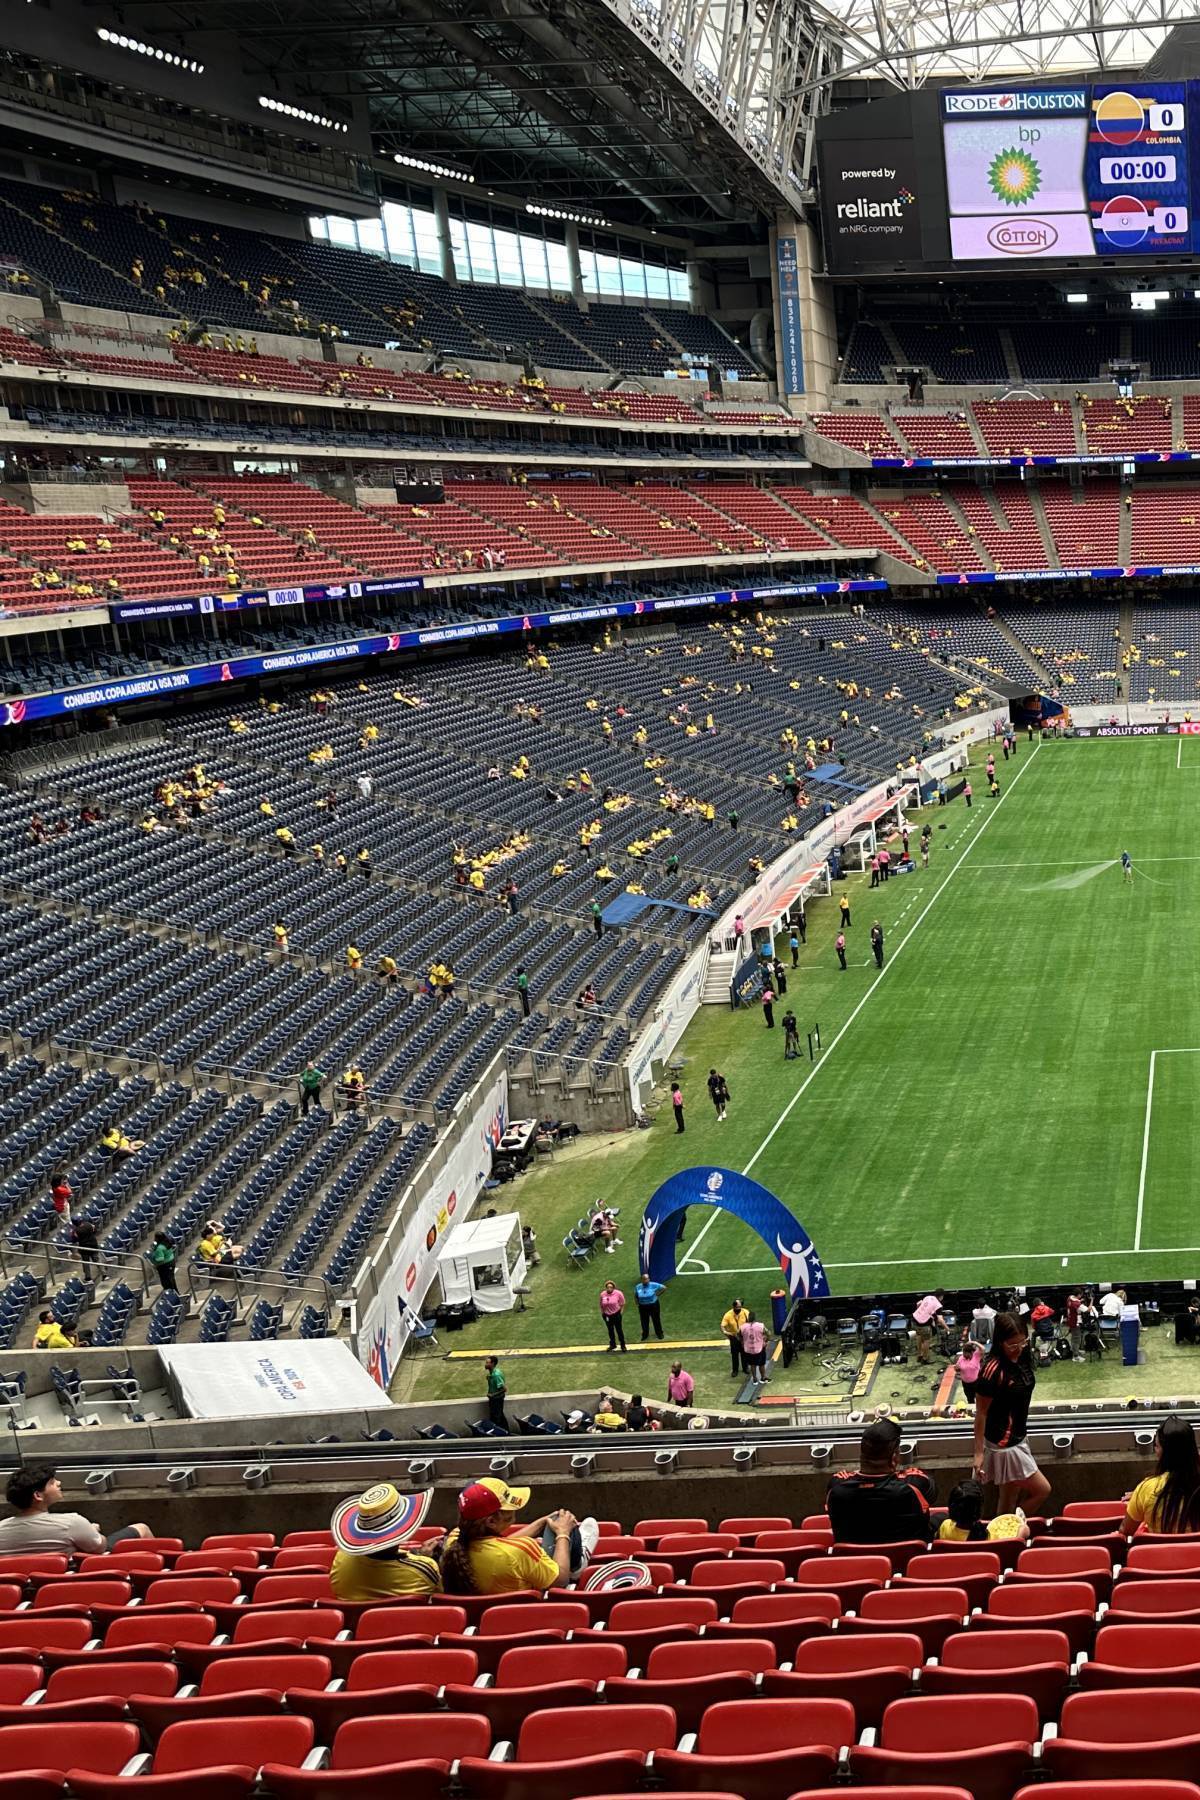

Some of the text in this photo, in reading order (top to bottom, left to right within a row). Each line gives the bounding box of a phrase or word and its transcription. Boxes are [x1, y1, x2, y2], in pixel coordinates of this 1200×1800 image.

[1161, 109, 1174, 127] 0
[1018, 125, 1042, 146] bp
[1145, 136, 1182, 145] COLOMBIA
[841, 167, 897, 181] powered by
[1110, 161, 1167, 180] 00:00
[837, 199, 904, 218] reliant
[839, 225, 904, 234] an NRG company
[1164, 212, 1177, 230] 0
[996, 227, 1047, 246] COTTON
[275, 590, 298, 604] 00:00
[64, 673, 190, 708] CONMEBOL COPA AMERICA USA 2024
[1096, 726, 1132, 736] ABSOLUT
[1133, 725, 1160, 735] SPORT
